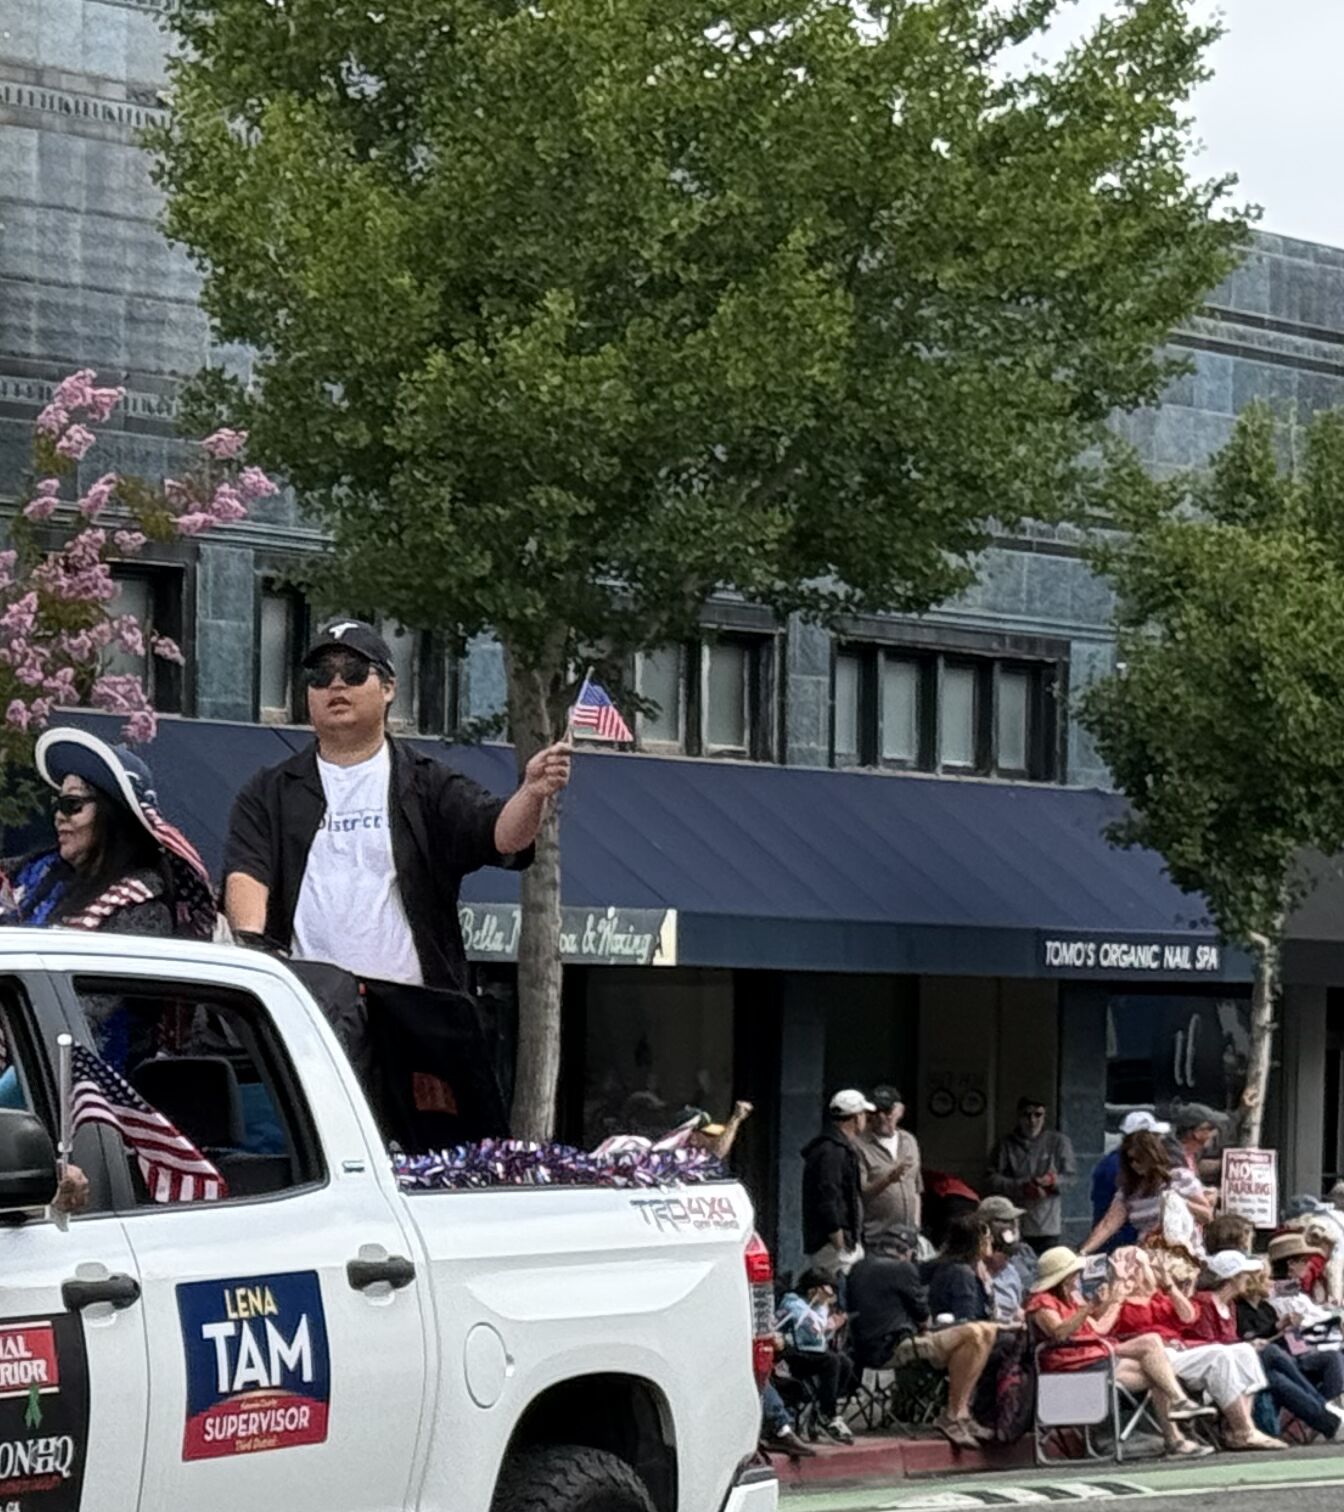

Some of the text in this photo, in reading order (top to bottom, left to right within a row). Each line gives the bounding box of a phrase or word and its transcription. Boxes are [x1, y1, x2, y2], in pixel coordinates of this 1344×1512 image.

[1045, 941, 1219, 971] TOMO'S ORGANIC NAIL SPA
[1228, 1161, 1252, 1180] NO
[223, 1285, 279, 1320] LENA
[201, 1313, 313, 1394] TAM
[203, 1405, 310, 1442] SUPERVISOR
